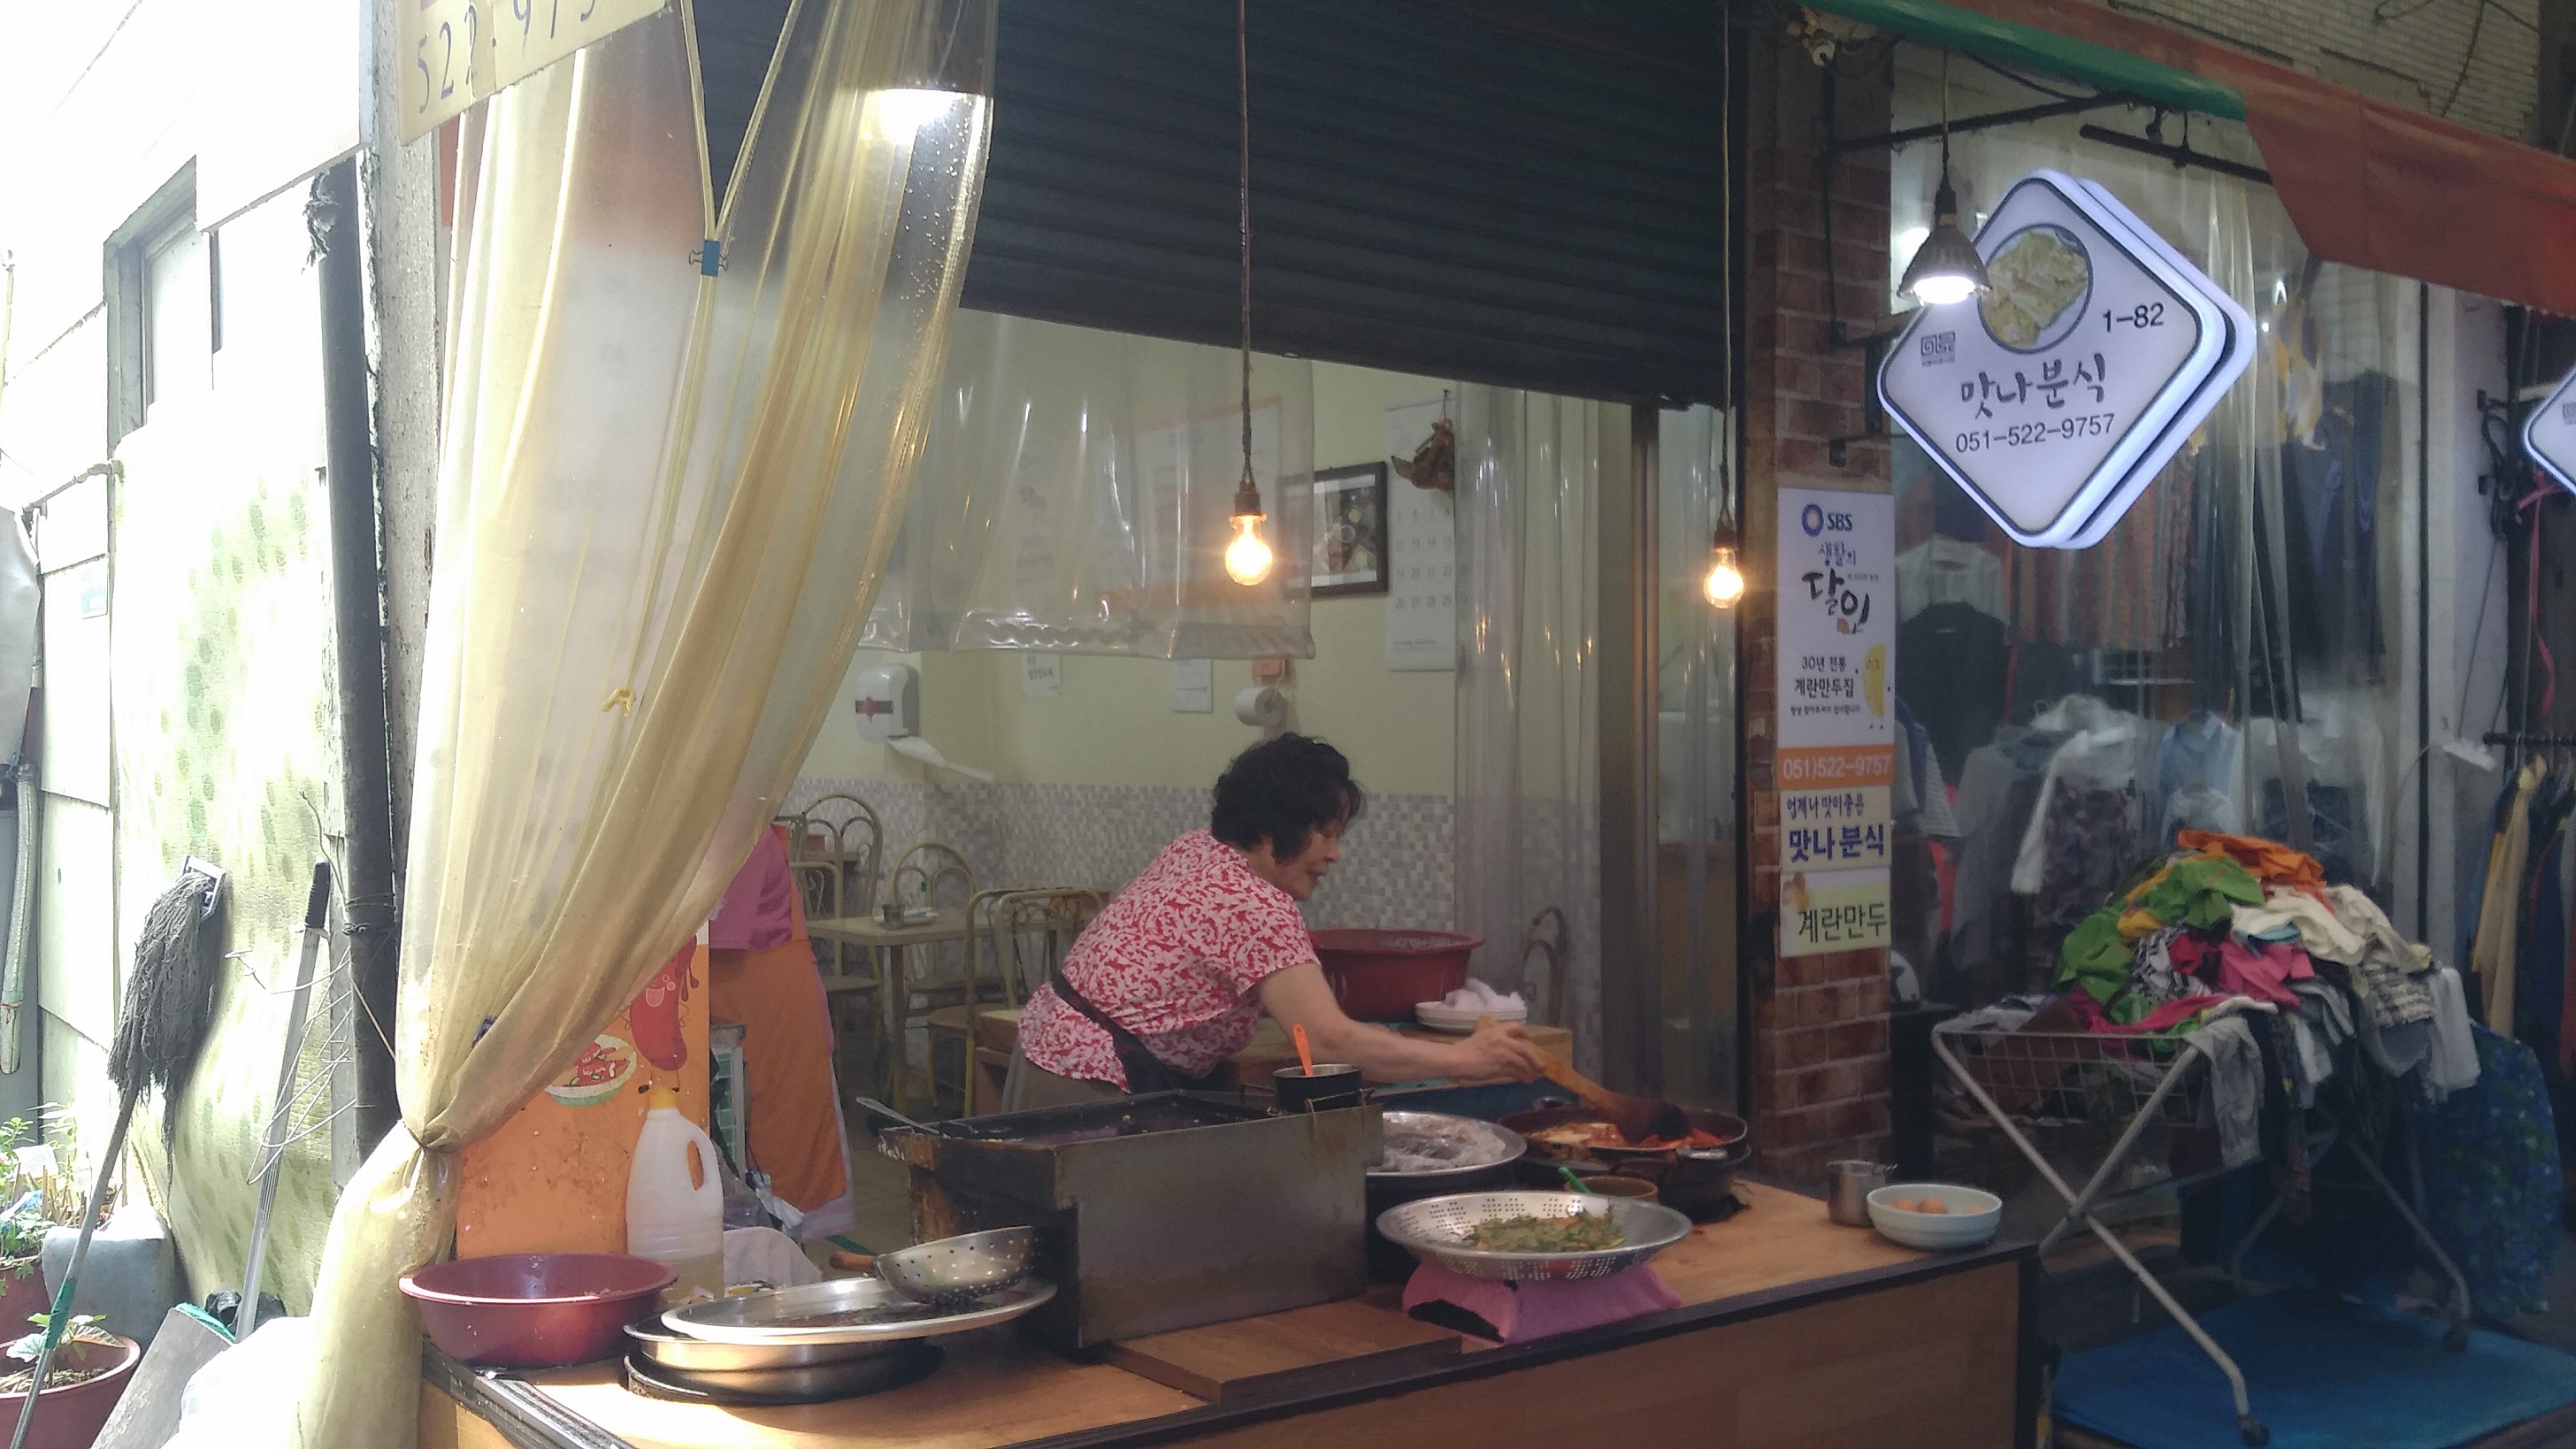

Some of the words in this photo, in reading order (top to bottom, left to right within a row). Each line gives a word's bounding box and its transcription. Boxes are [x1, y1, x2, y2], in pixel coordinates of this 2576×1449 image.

[2103, 302, 2165, 333] 1-82
[1961, 353, 2106, 420] 맛나분식
[1955, 413, 2116, 454] 051-522-9757
[1828, 512, 1853, 531] SBS
[1443, 594, 1452, 607] 29
[1802, 568, 1870, 635] 달인
[1802, 656, 1825, 672] 30년
[1794, 677, 1854, 698] 계란만두집
[1789, 824, 1884, 862] 맛나분식
[1798, 902, 1887, 943] 계란만두
